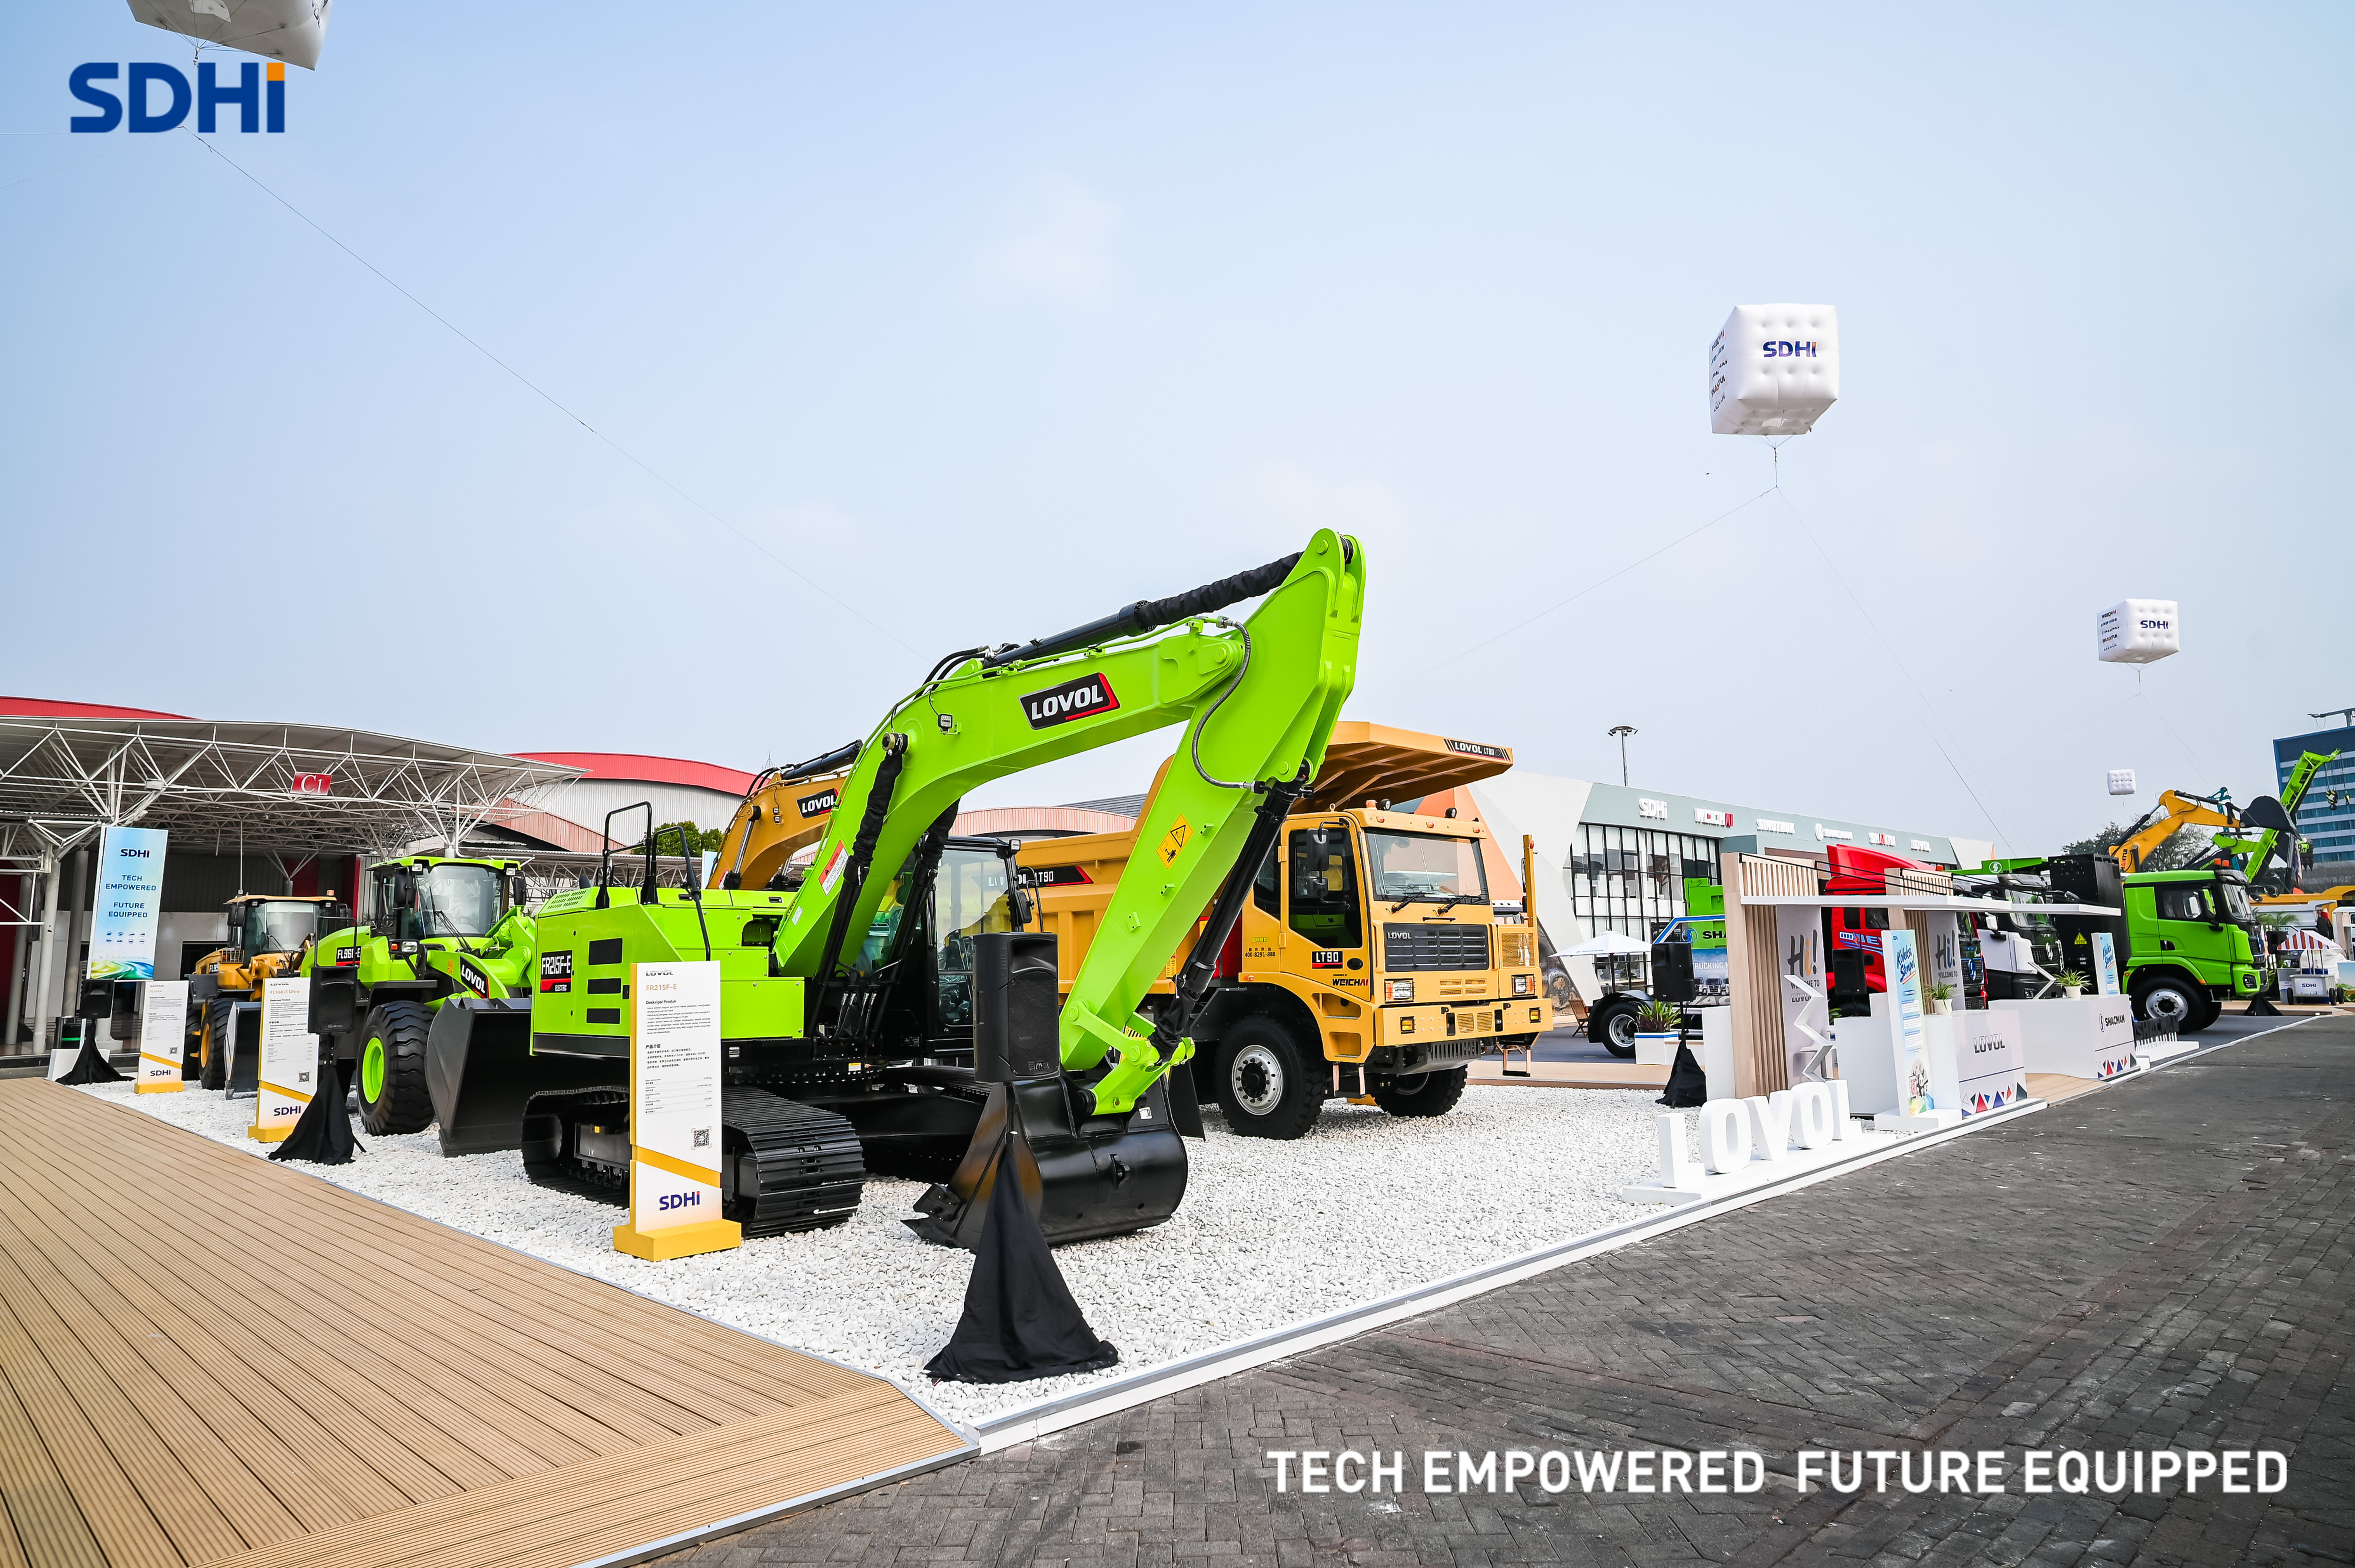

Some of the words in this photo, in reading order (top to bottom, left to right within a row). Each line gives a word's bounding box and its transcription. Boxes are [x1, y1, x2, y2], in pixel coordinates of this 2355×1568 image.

[1031, 685, 1103, 720] LOVOL
[1454, 742, 1482, 754] LOVOL
[301, 775, 322, 793] C1
[1702, 930, 1726, 939] SH
[1316, 952, 1339, 962] LT90
[1897, 943, 1912, 969] Koleksi
[1935, 929, 1956, 970] Hi!
[541, 955, 571, 975] FR215F-E
[461, 964, 485, 994] LOVOL
[2105, 1014, 2125, 1026] SHACMAN
[2136, 1015, 2179, 1041] SHACMAN
[1973, 1033, 2005, 1053] LOVOL
[1657, 1079, 1862, 1188] LOVOL
